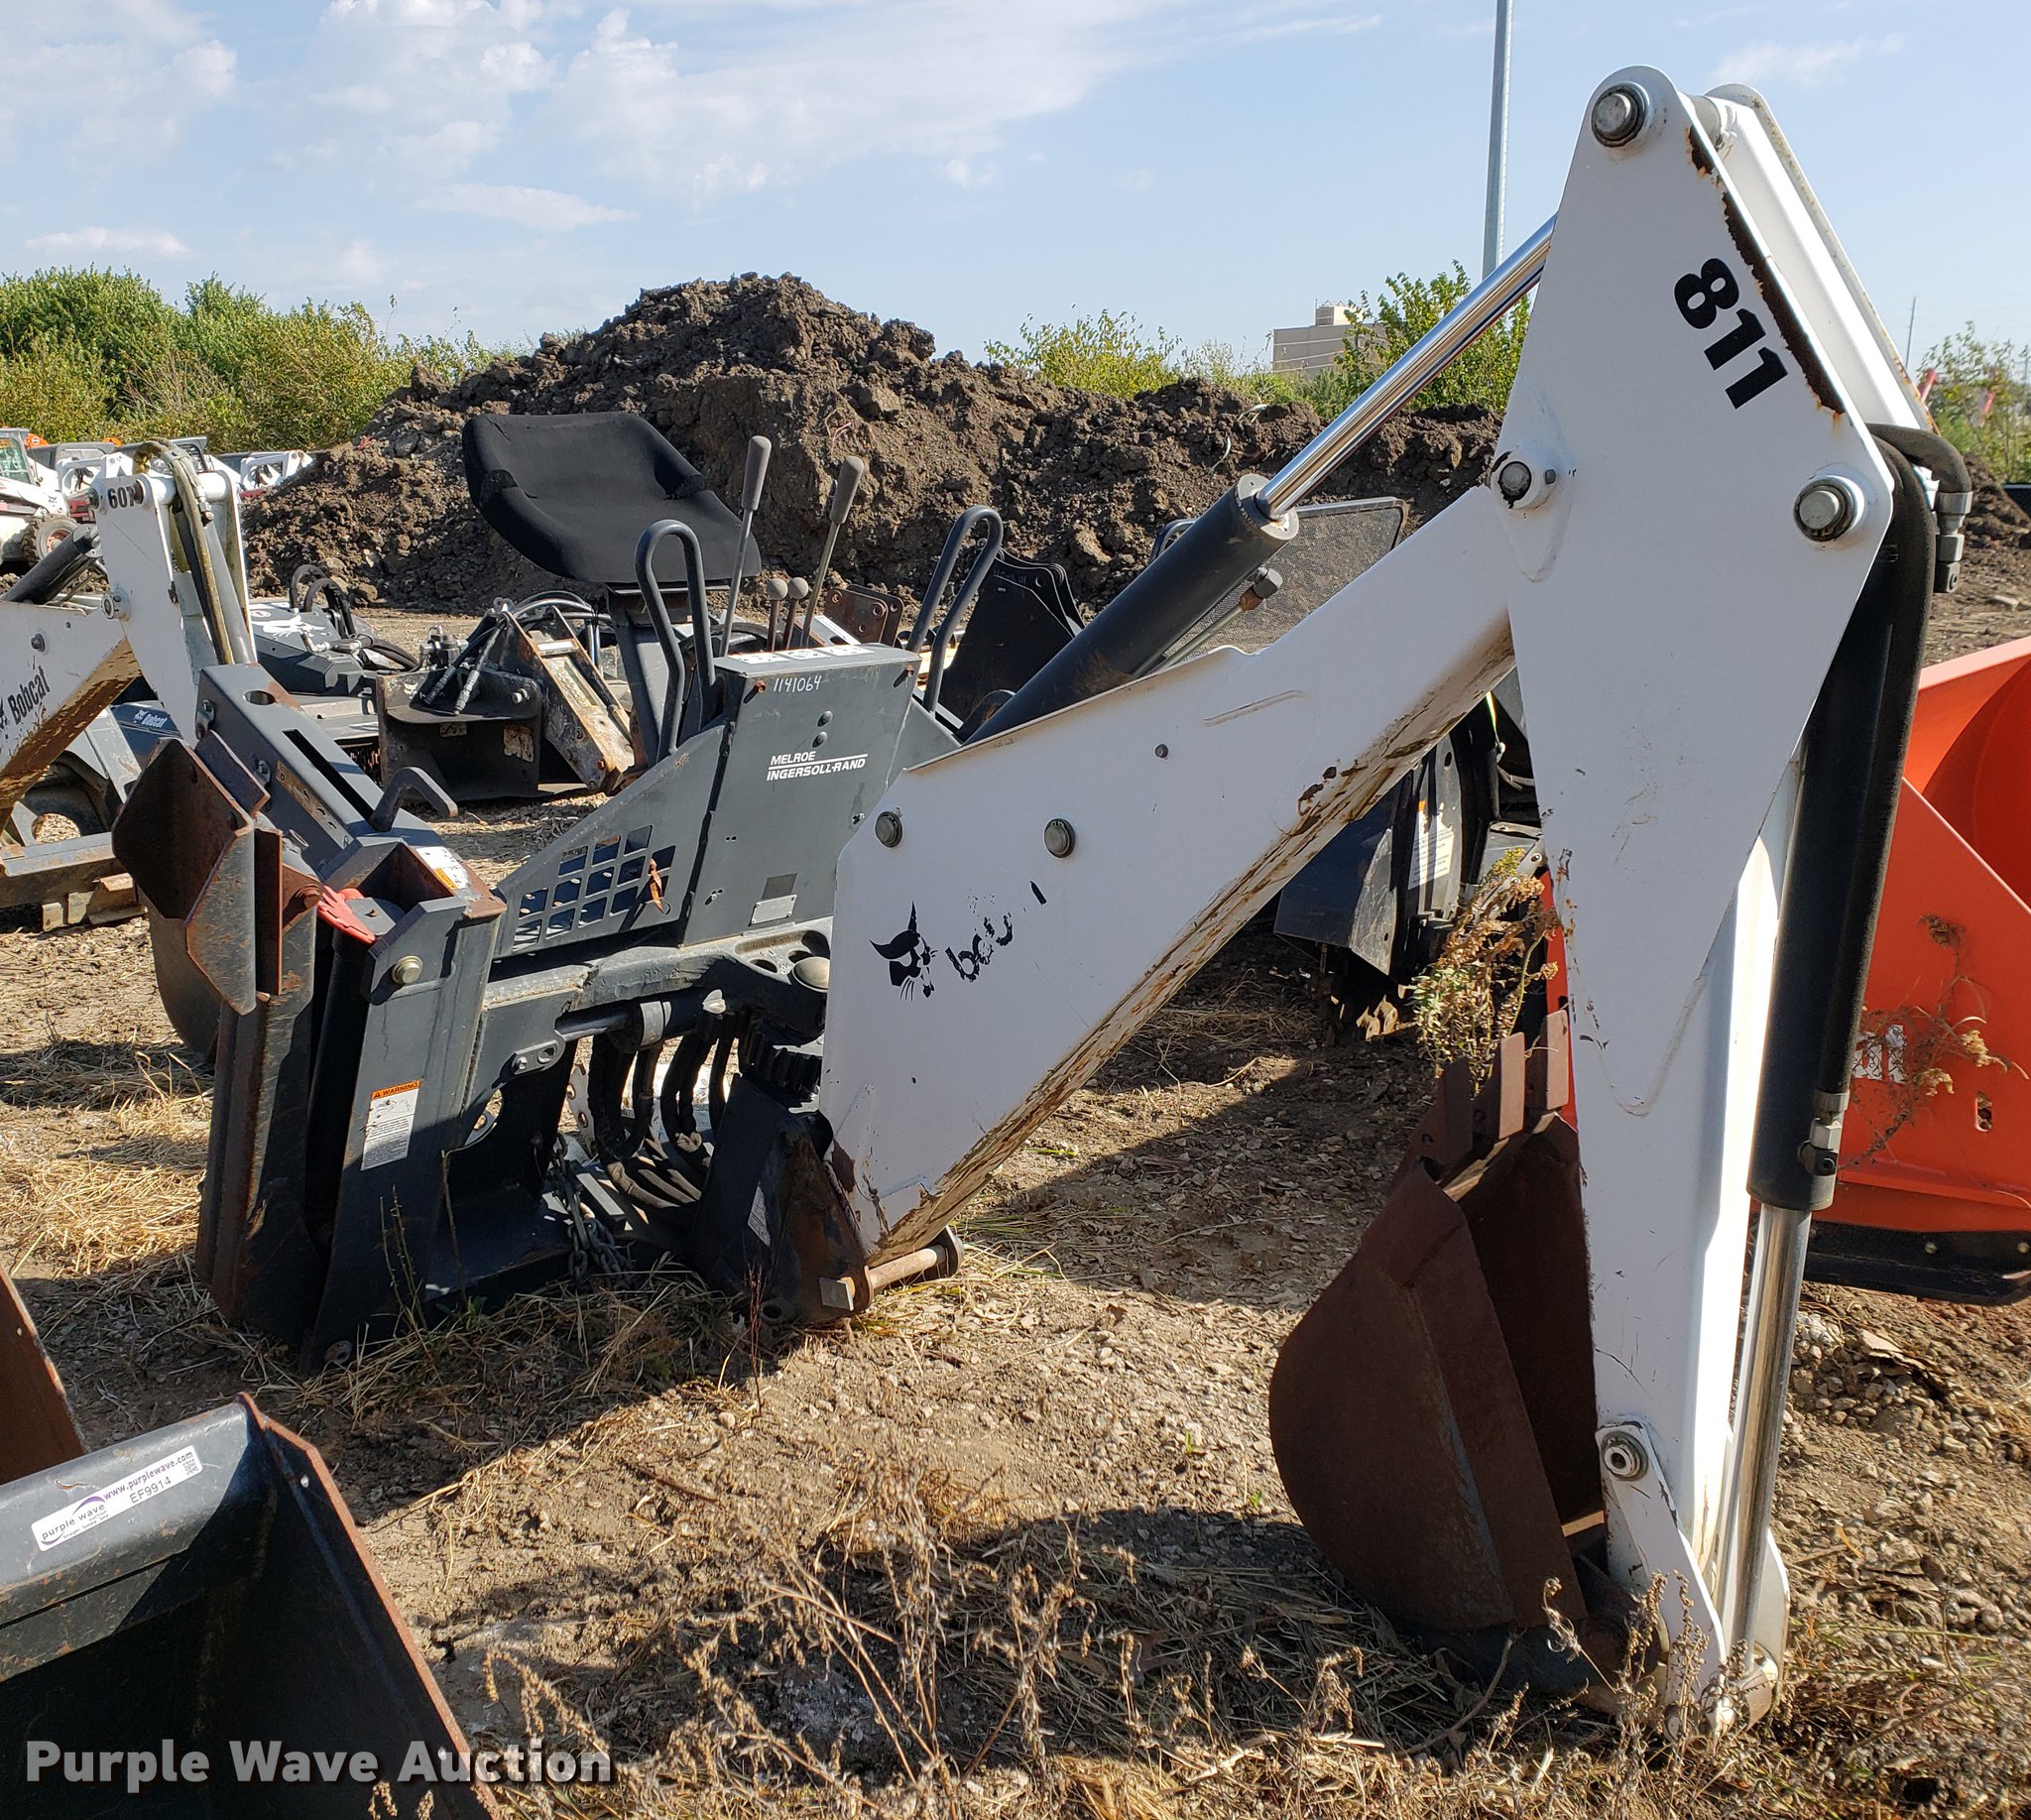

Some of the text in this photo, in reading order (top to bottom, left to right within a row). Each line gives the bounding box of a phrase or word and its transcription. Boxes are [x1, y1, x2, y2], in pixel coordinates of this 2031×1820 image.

[1674, 258, 1788, 410] 811
[7, 665, 51, 725] Bobcat
[774, 675, 822, 692] 1141064
[767, 758, 866, 782] INGERSOLL-RAND
[771, 751, 816, 766] MELROE
[383, 1082, 418, 1096] WARNING
[103, 1451, 193, 1501] www.purplewave.com
[130, 1476, 172, 1504] EF9914
[42, 1518, 75, 1540] purple
[78, 1504, 105, 1520] wave
